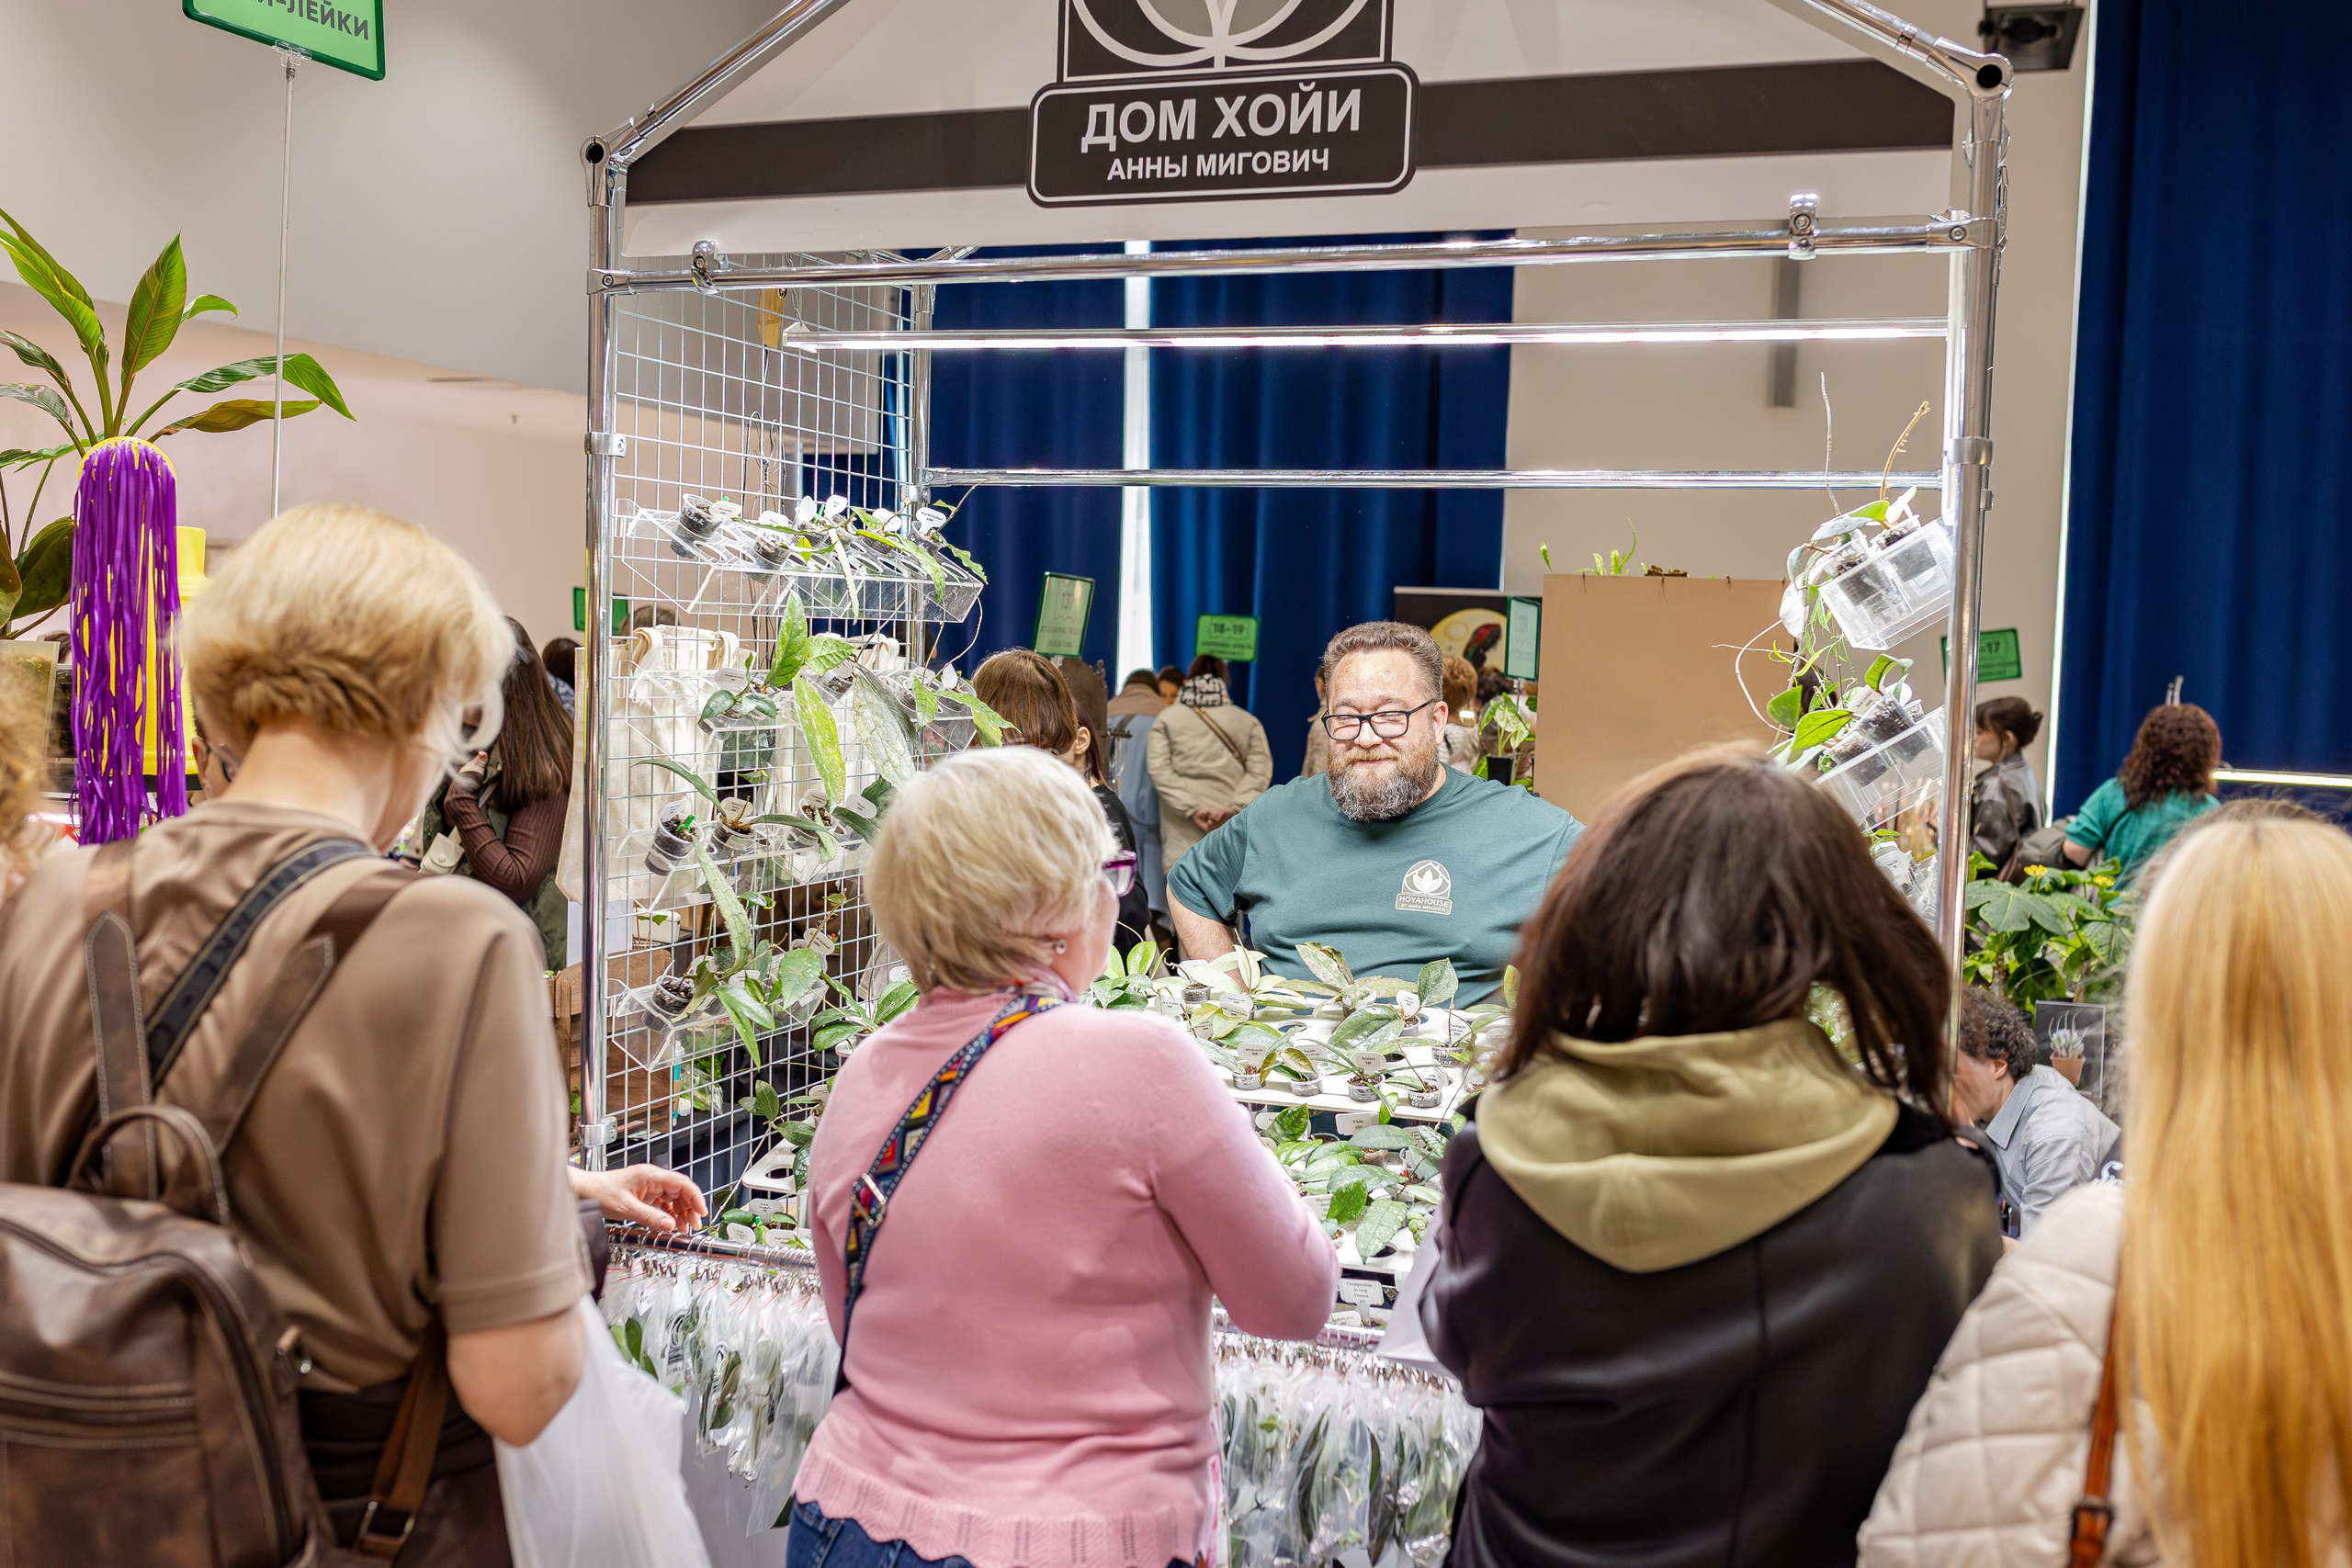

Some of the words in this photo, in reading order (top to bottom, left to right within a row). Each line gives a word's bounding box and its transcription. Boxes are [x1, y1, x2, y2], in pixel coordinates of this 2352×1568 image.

[1080, 98, 1195, 153] ДОМ
[1211, 81, 1361, 139] ХОЙИ
[1106, 155, 1187, 181] АННЫ
[1196, 148, 1329, 177] МИГОВИЧ
[1398, 895, 1450, 908] HOYAHOUSE
